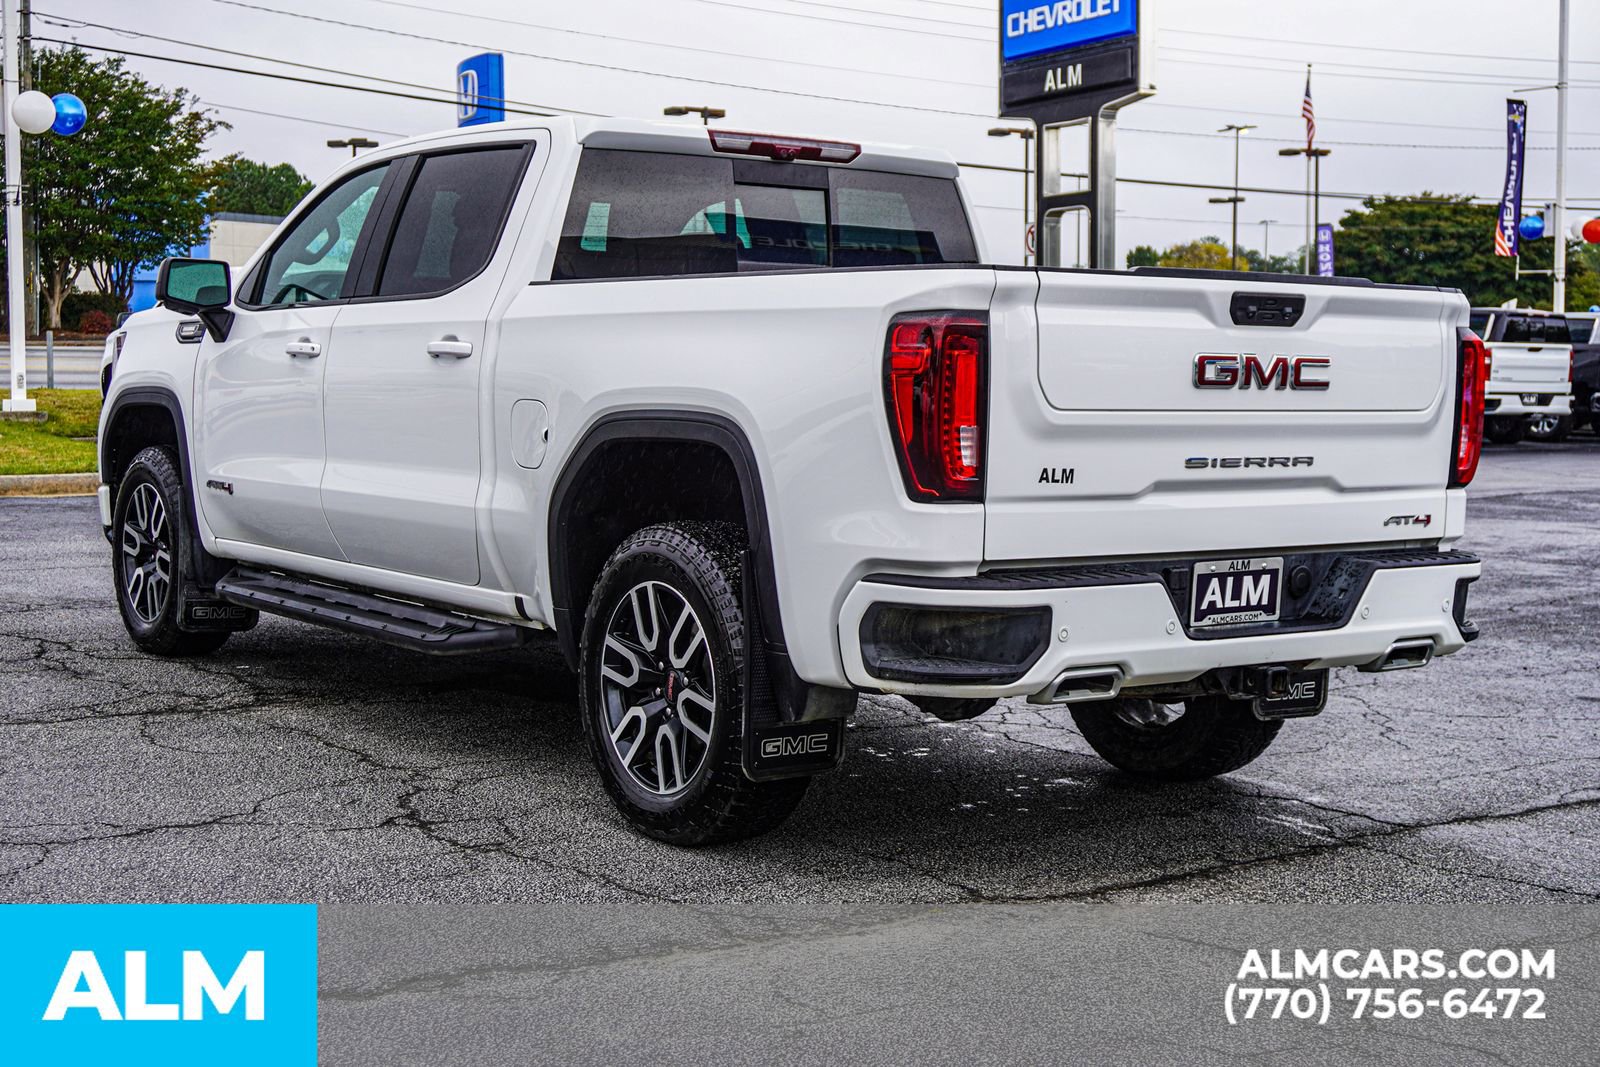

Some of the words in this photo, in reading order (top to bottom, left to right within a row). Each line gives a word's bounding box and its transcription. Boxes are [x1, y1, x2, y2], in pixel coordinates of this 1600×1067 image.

[1043, 63, 1083, 92] ALM
[1192, 351, 1331, 391] GMC
[1184, 457, 1314, 469] SIERRA
[1038, 467, 1075, 484] ALM
[1383, 514, 1432, 528] AT4
[1228, 559, 1251, 571] ALM
[1200, 574, 1271, 610] ALM
[192, 606, 246, 619] GMC
[1211, 613, 1259, 624] ALMCARS.COM
[1266, 681, 1316, 701] MC
[761, 733, 828, 758] GMC
